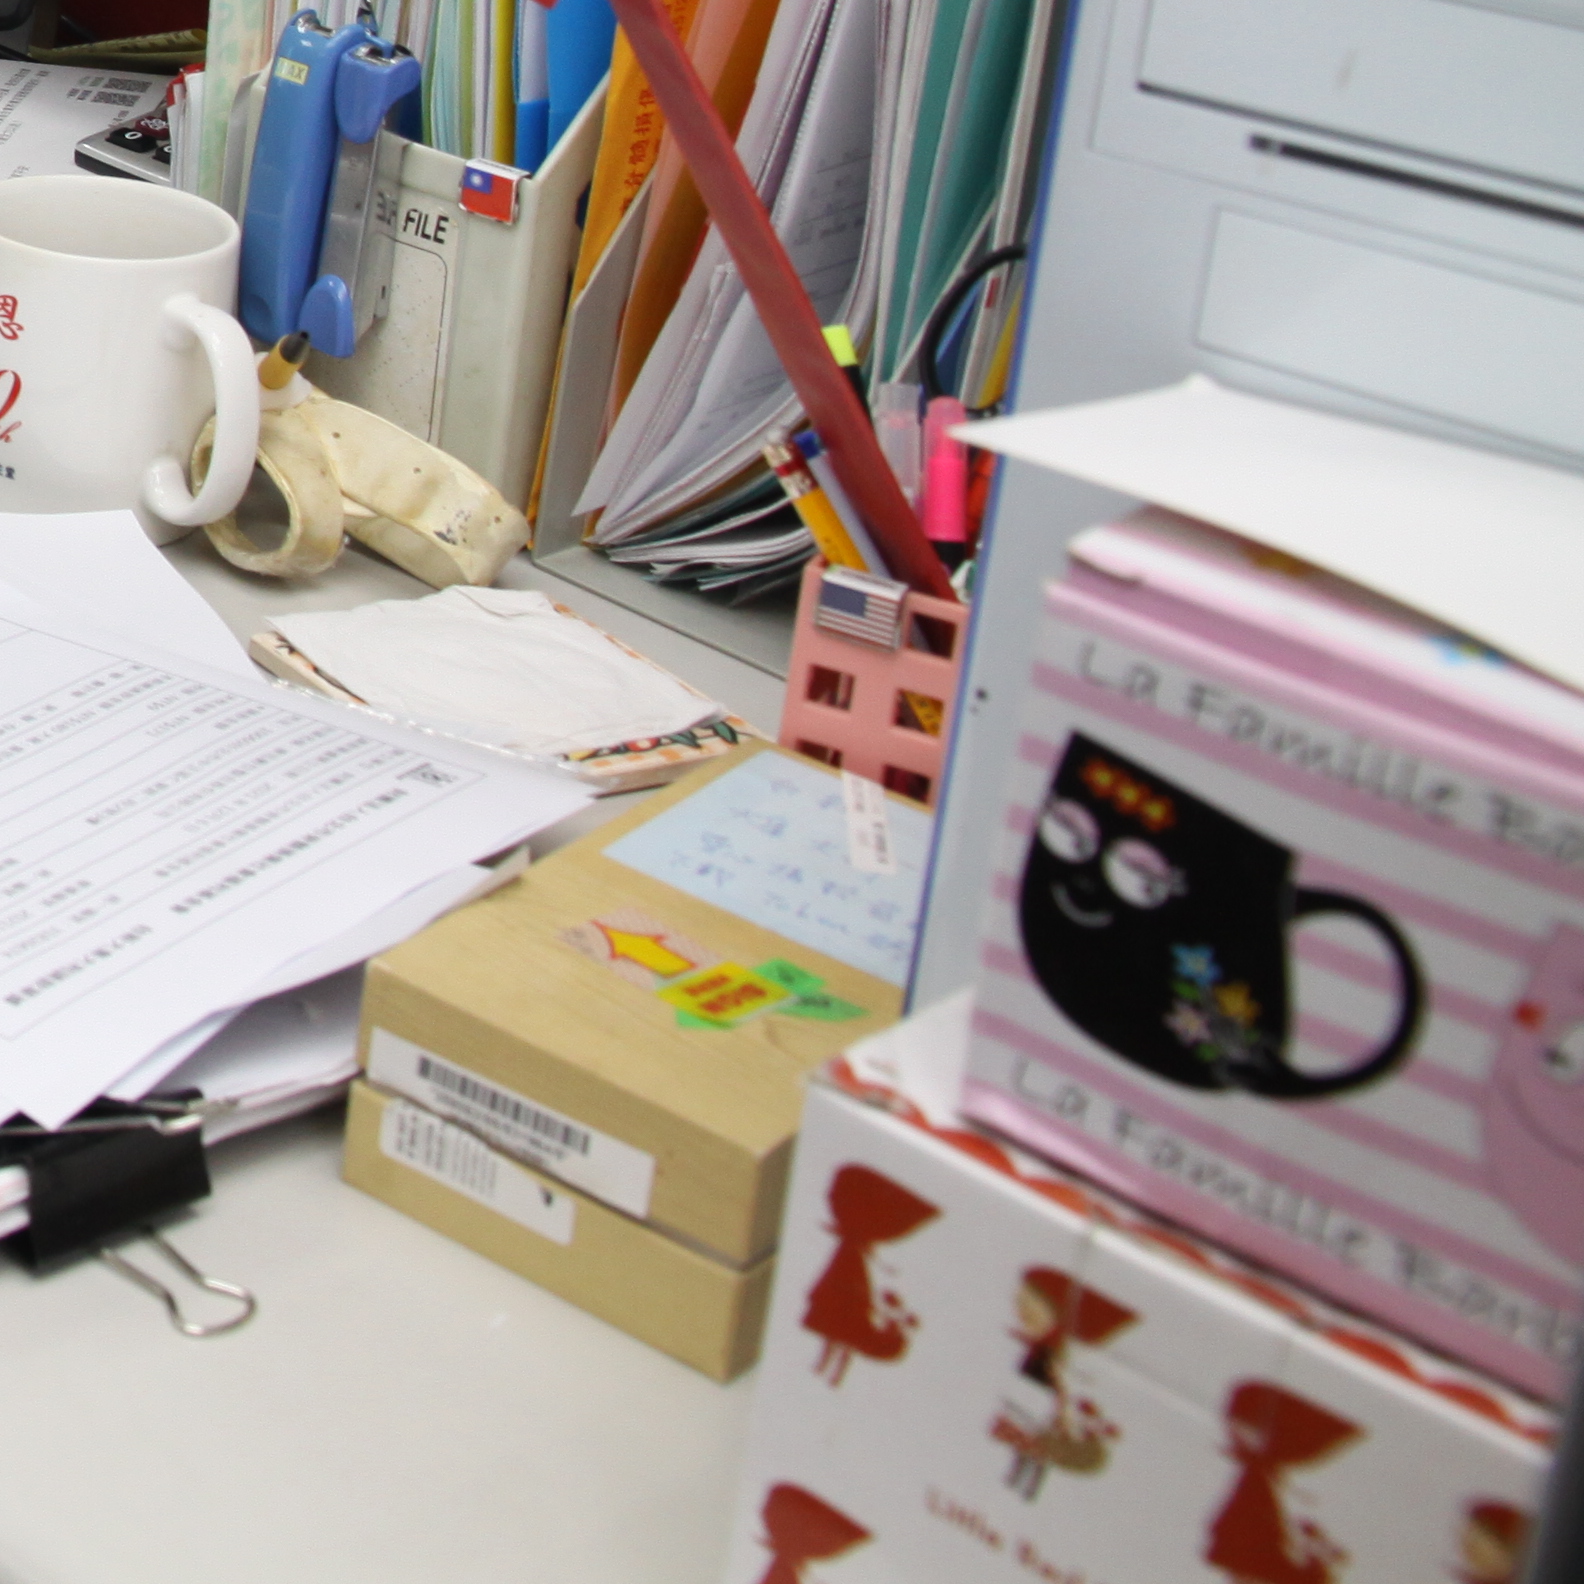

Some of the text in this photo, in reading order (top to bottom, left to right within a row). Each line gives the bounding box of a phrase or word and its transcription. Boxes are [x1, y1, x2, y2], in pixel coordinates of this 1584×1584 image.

[403, 208, 449, 244] FILE
[1078, 639, 1460, 810] La Famille
[1012, 1054, 1367, 1256] La Famille
